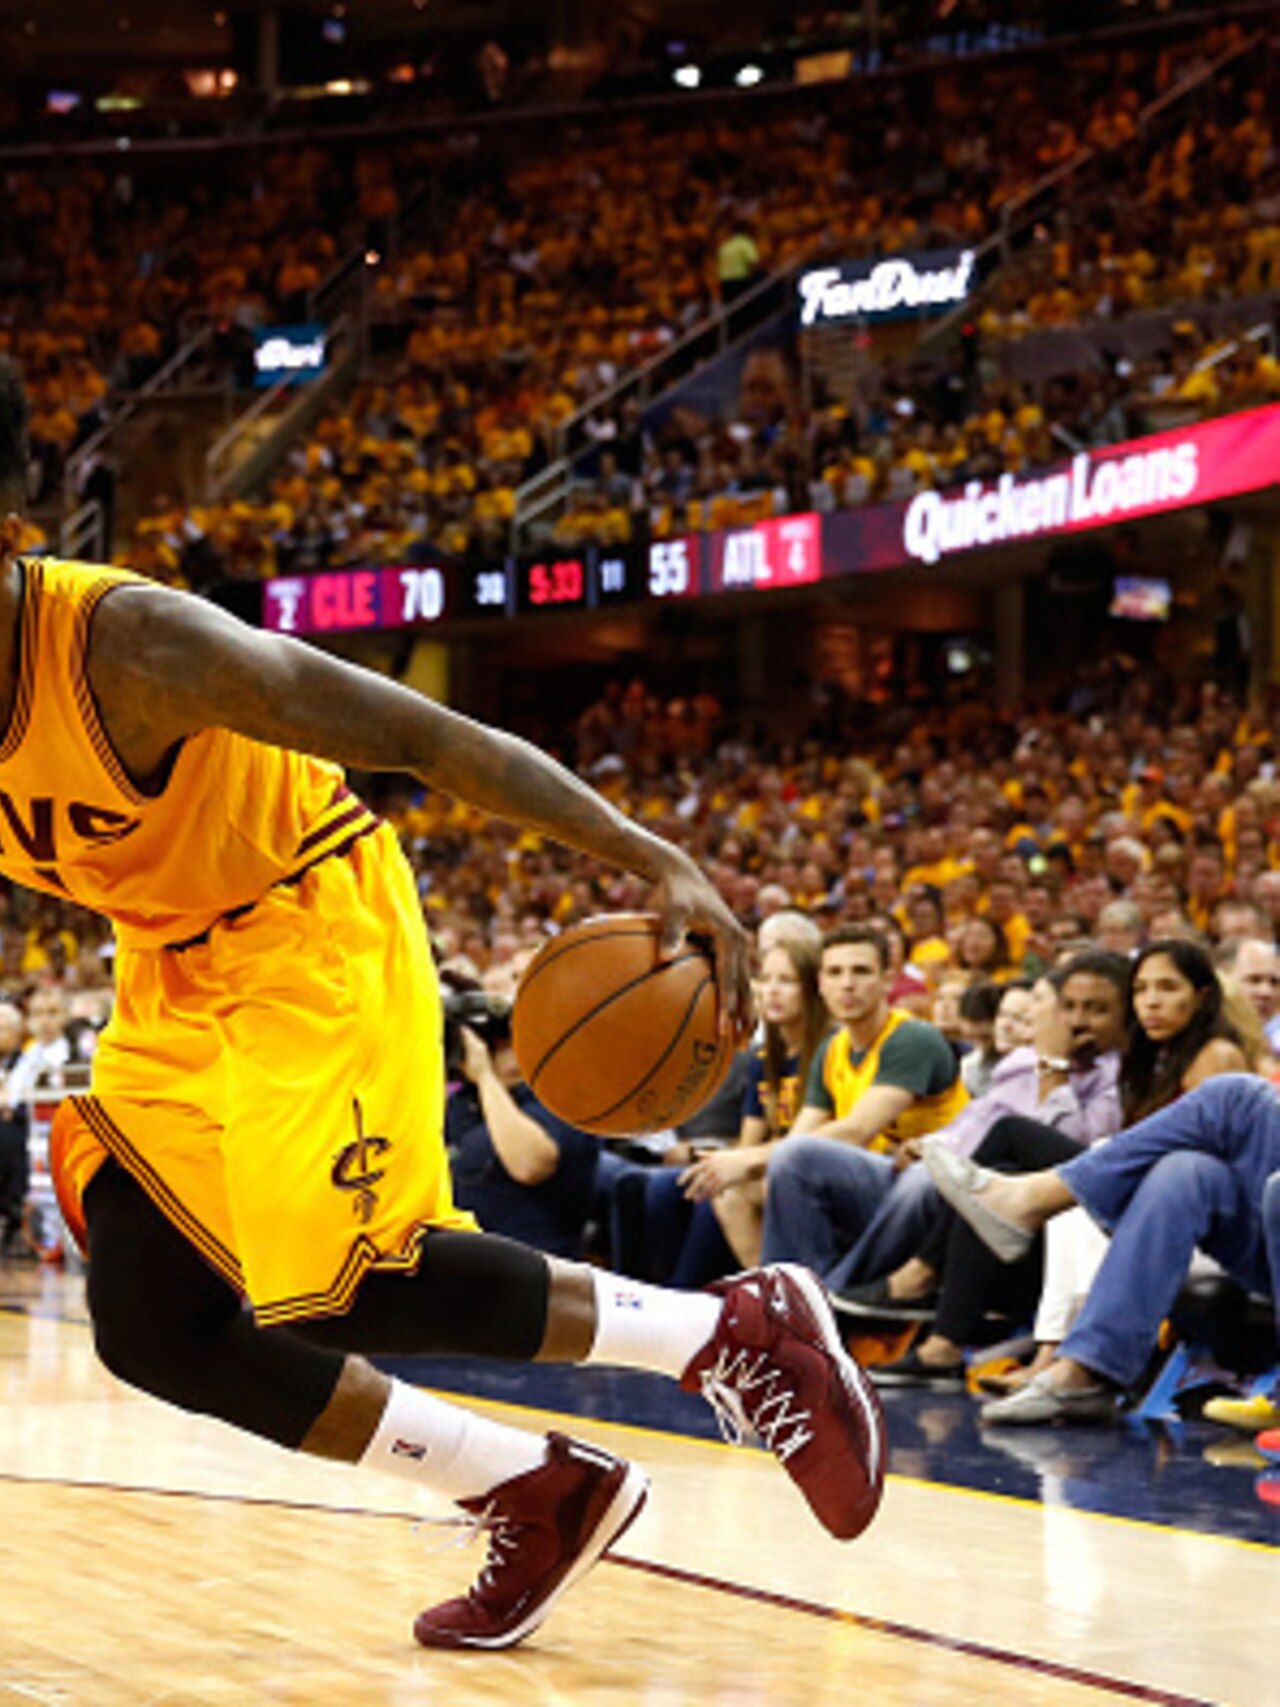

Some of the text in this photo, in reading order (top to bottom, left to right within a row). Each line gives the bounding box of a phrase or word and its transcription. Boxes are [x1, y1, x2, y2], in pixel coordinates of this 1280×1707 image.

[800, 250, 975, 325] FanDuel
[903, 442, 1198, 565] Quicken Loans
[312, 571, 376, 629] CLE
[400, 568, 444, 621] 70
[640, 541, 688, 596] 55
[723, 530, 772, 585] ATL
